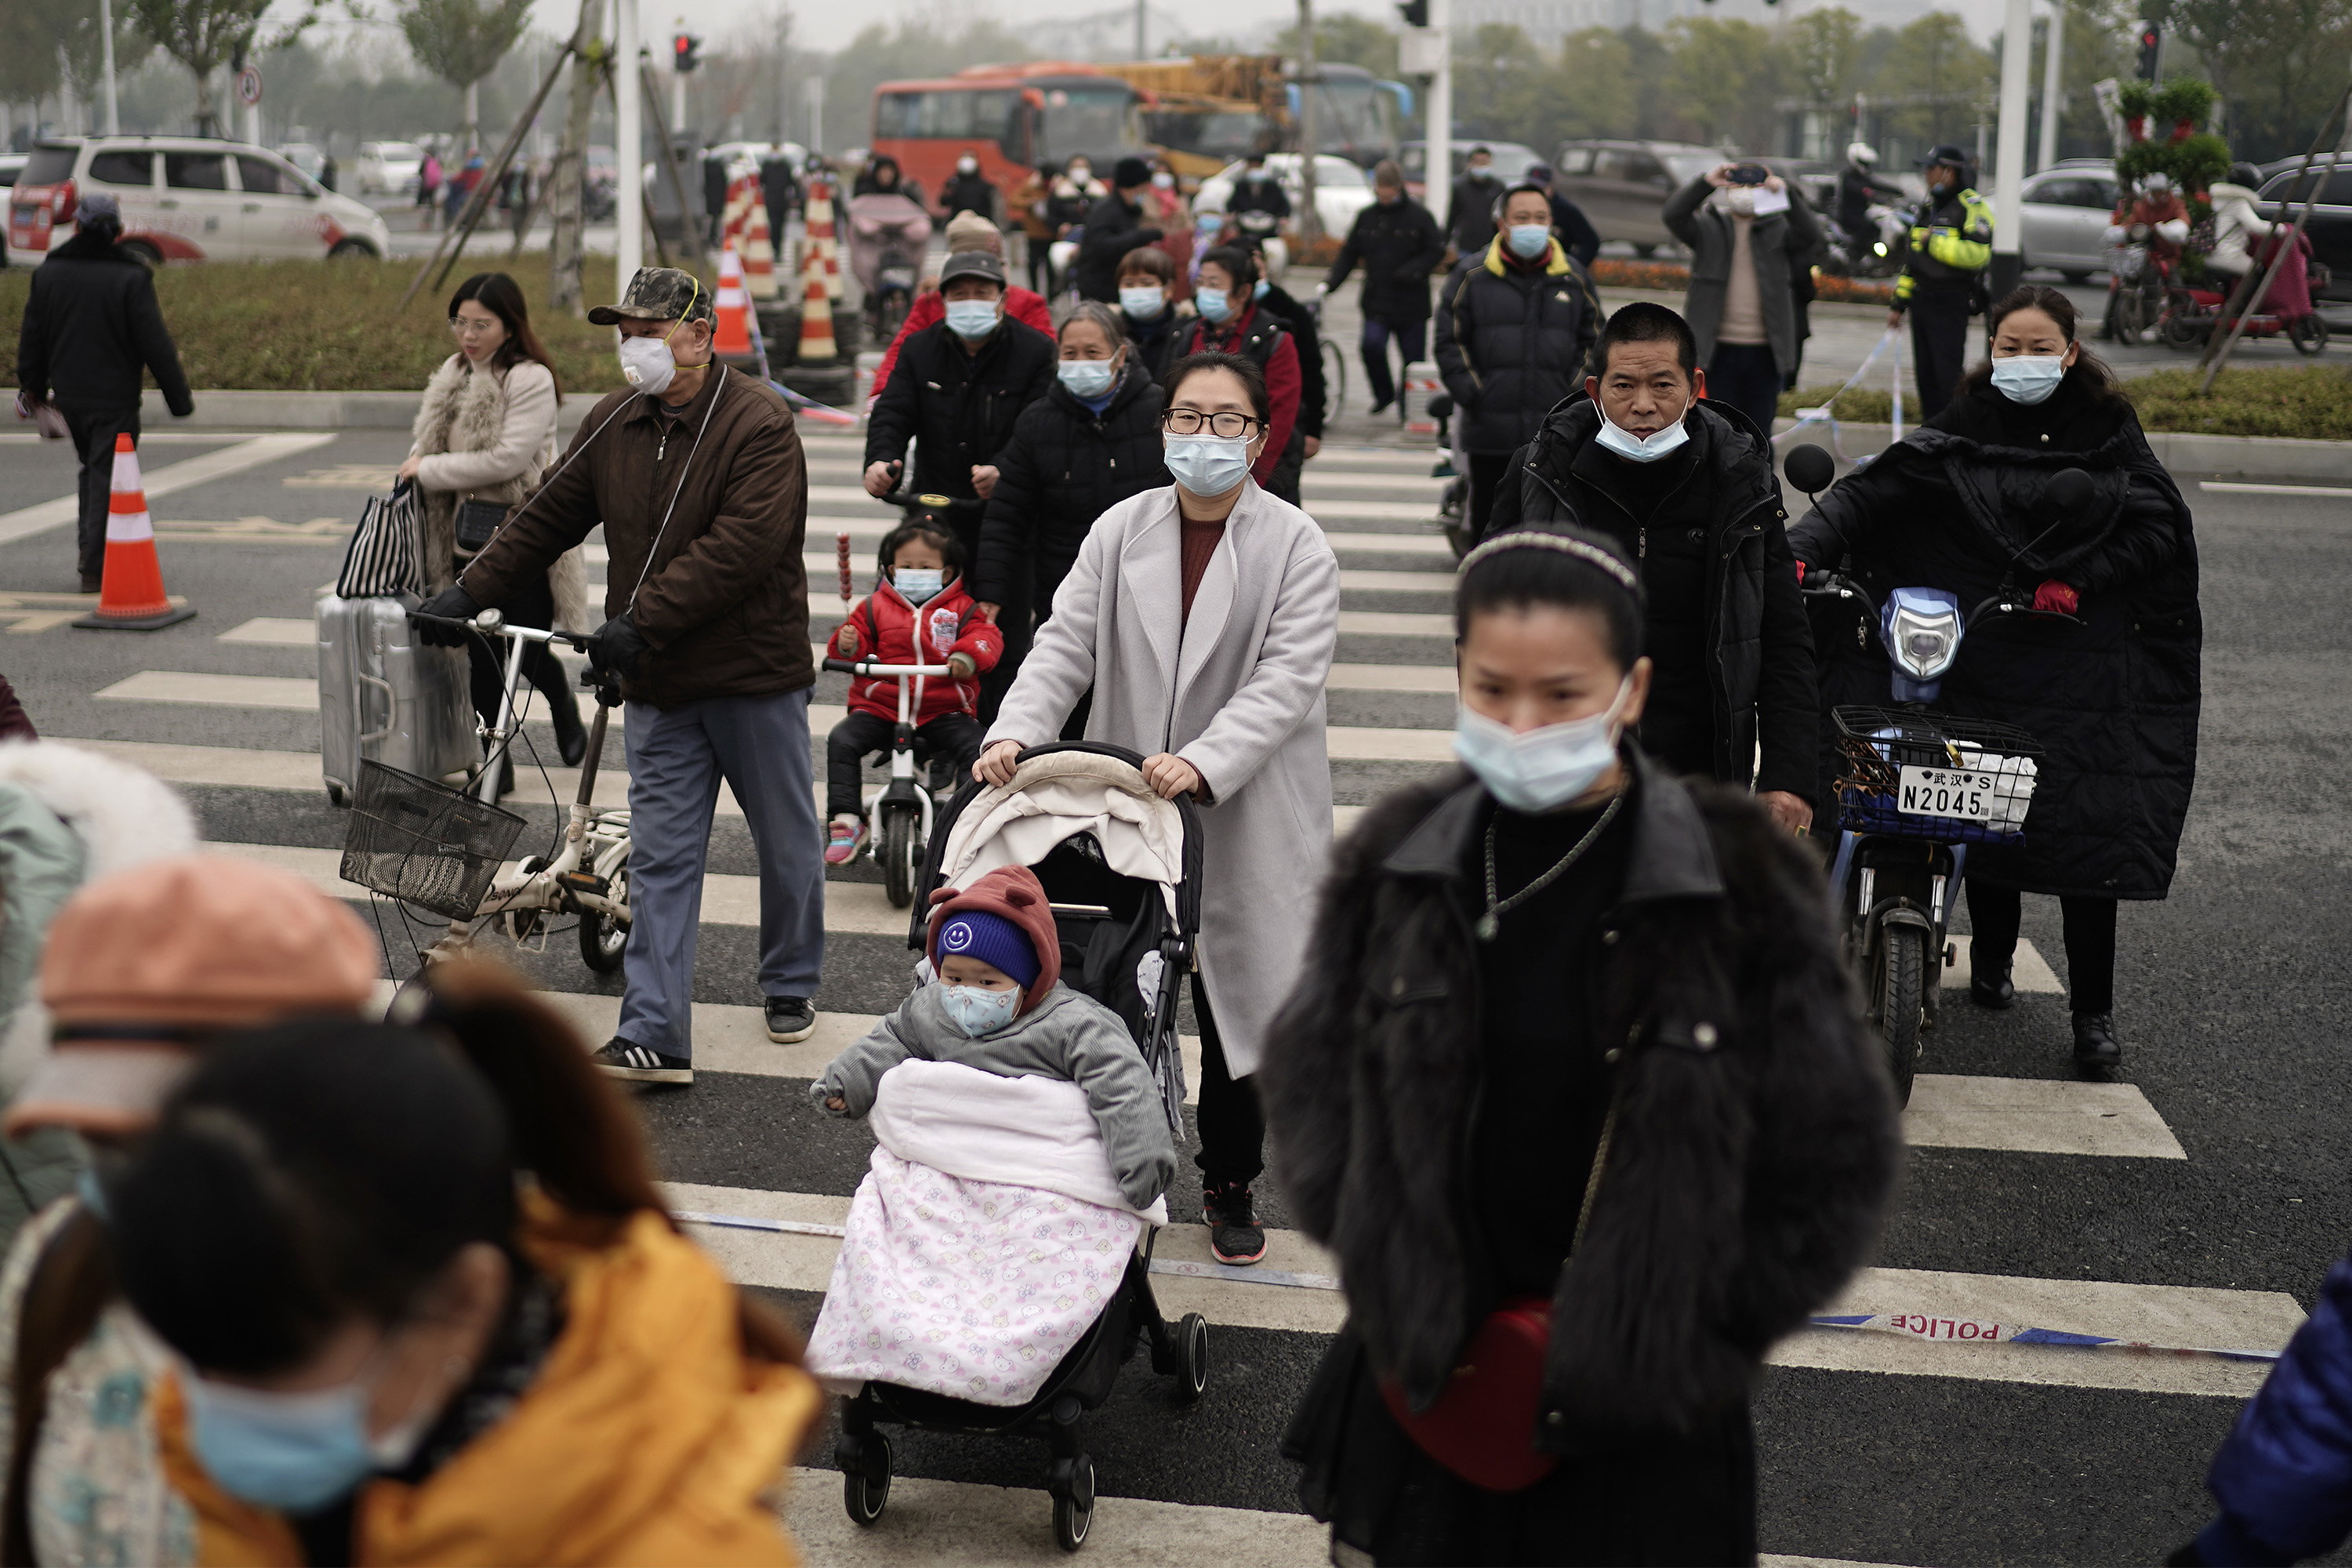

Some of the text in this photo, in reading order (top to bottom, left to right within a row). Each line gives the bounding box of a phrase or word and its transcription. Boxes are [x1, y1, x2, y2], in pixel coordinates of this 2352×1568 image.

[1933, 772, 1991, 789] 武汉 S
[1904, 786, 1981, 815] N2045
[1891, 1315, 1999, 1339] POLICE
